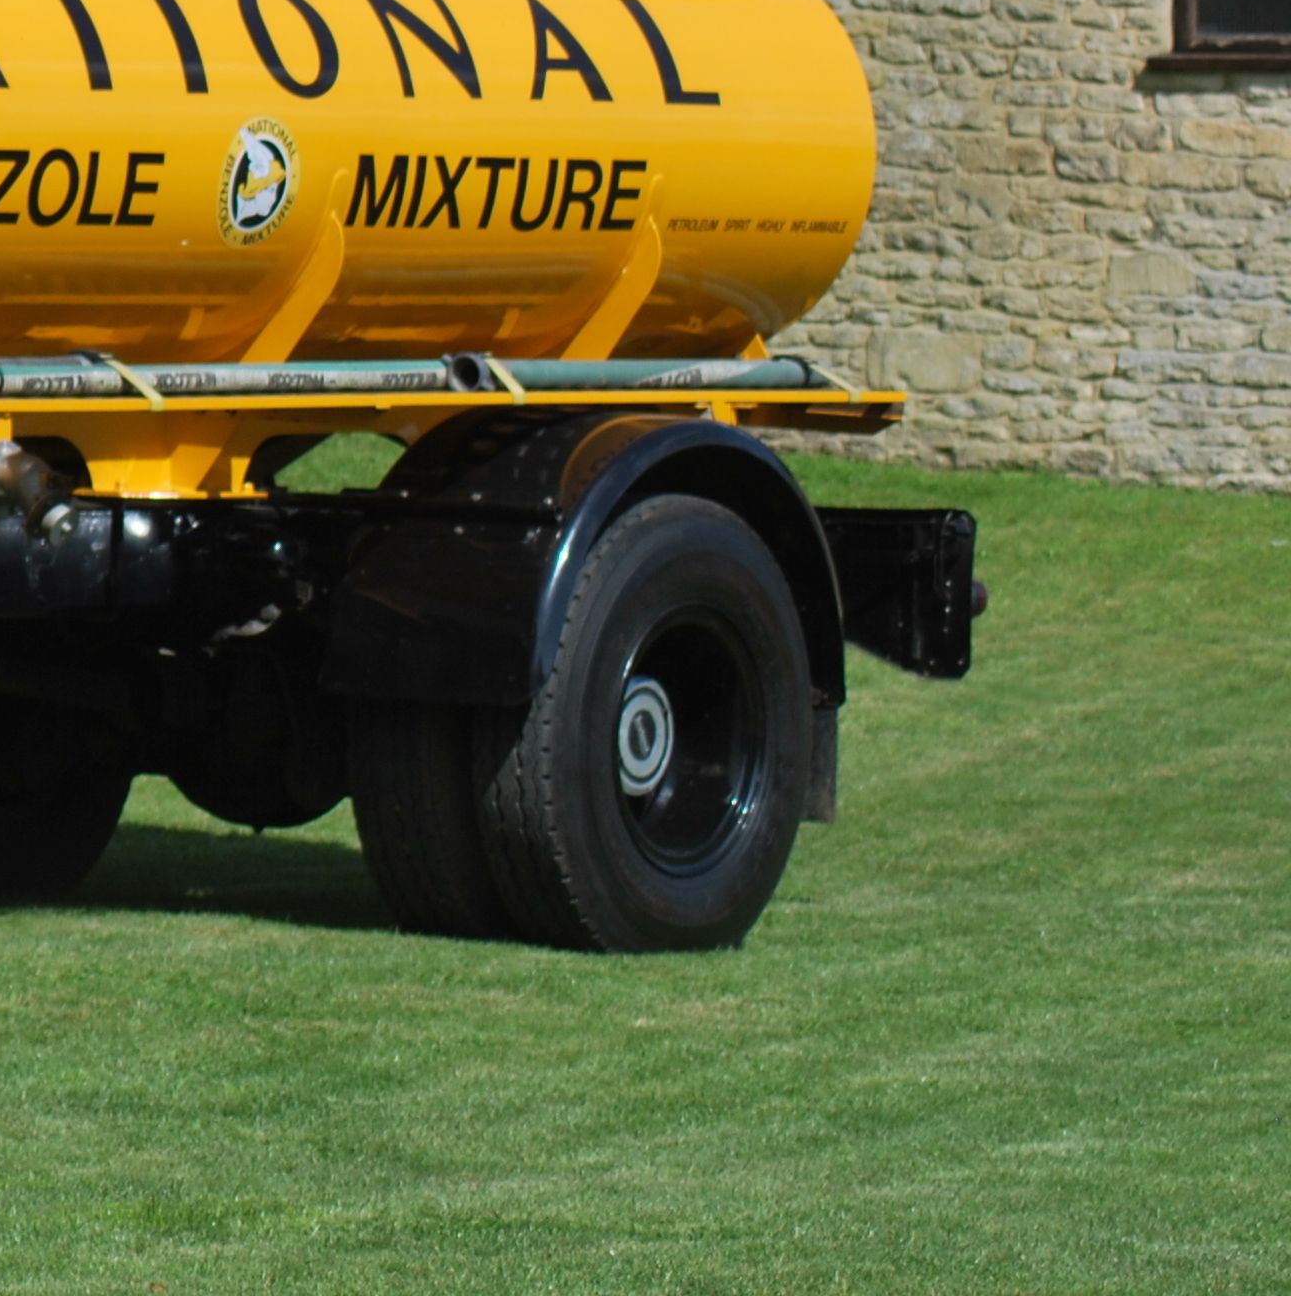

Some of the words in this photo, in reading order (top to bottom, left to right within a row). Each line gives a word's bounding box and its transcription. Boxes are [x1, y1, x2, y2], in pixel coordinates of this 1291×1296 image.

[247, 118, 297, 158] NATIONAL
[344, 154, 648, 232] MIXTURE
[241, 195, 295, 246] MIXTURE
